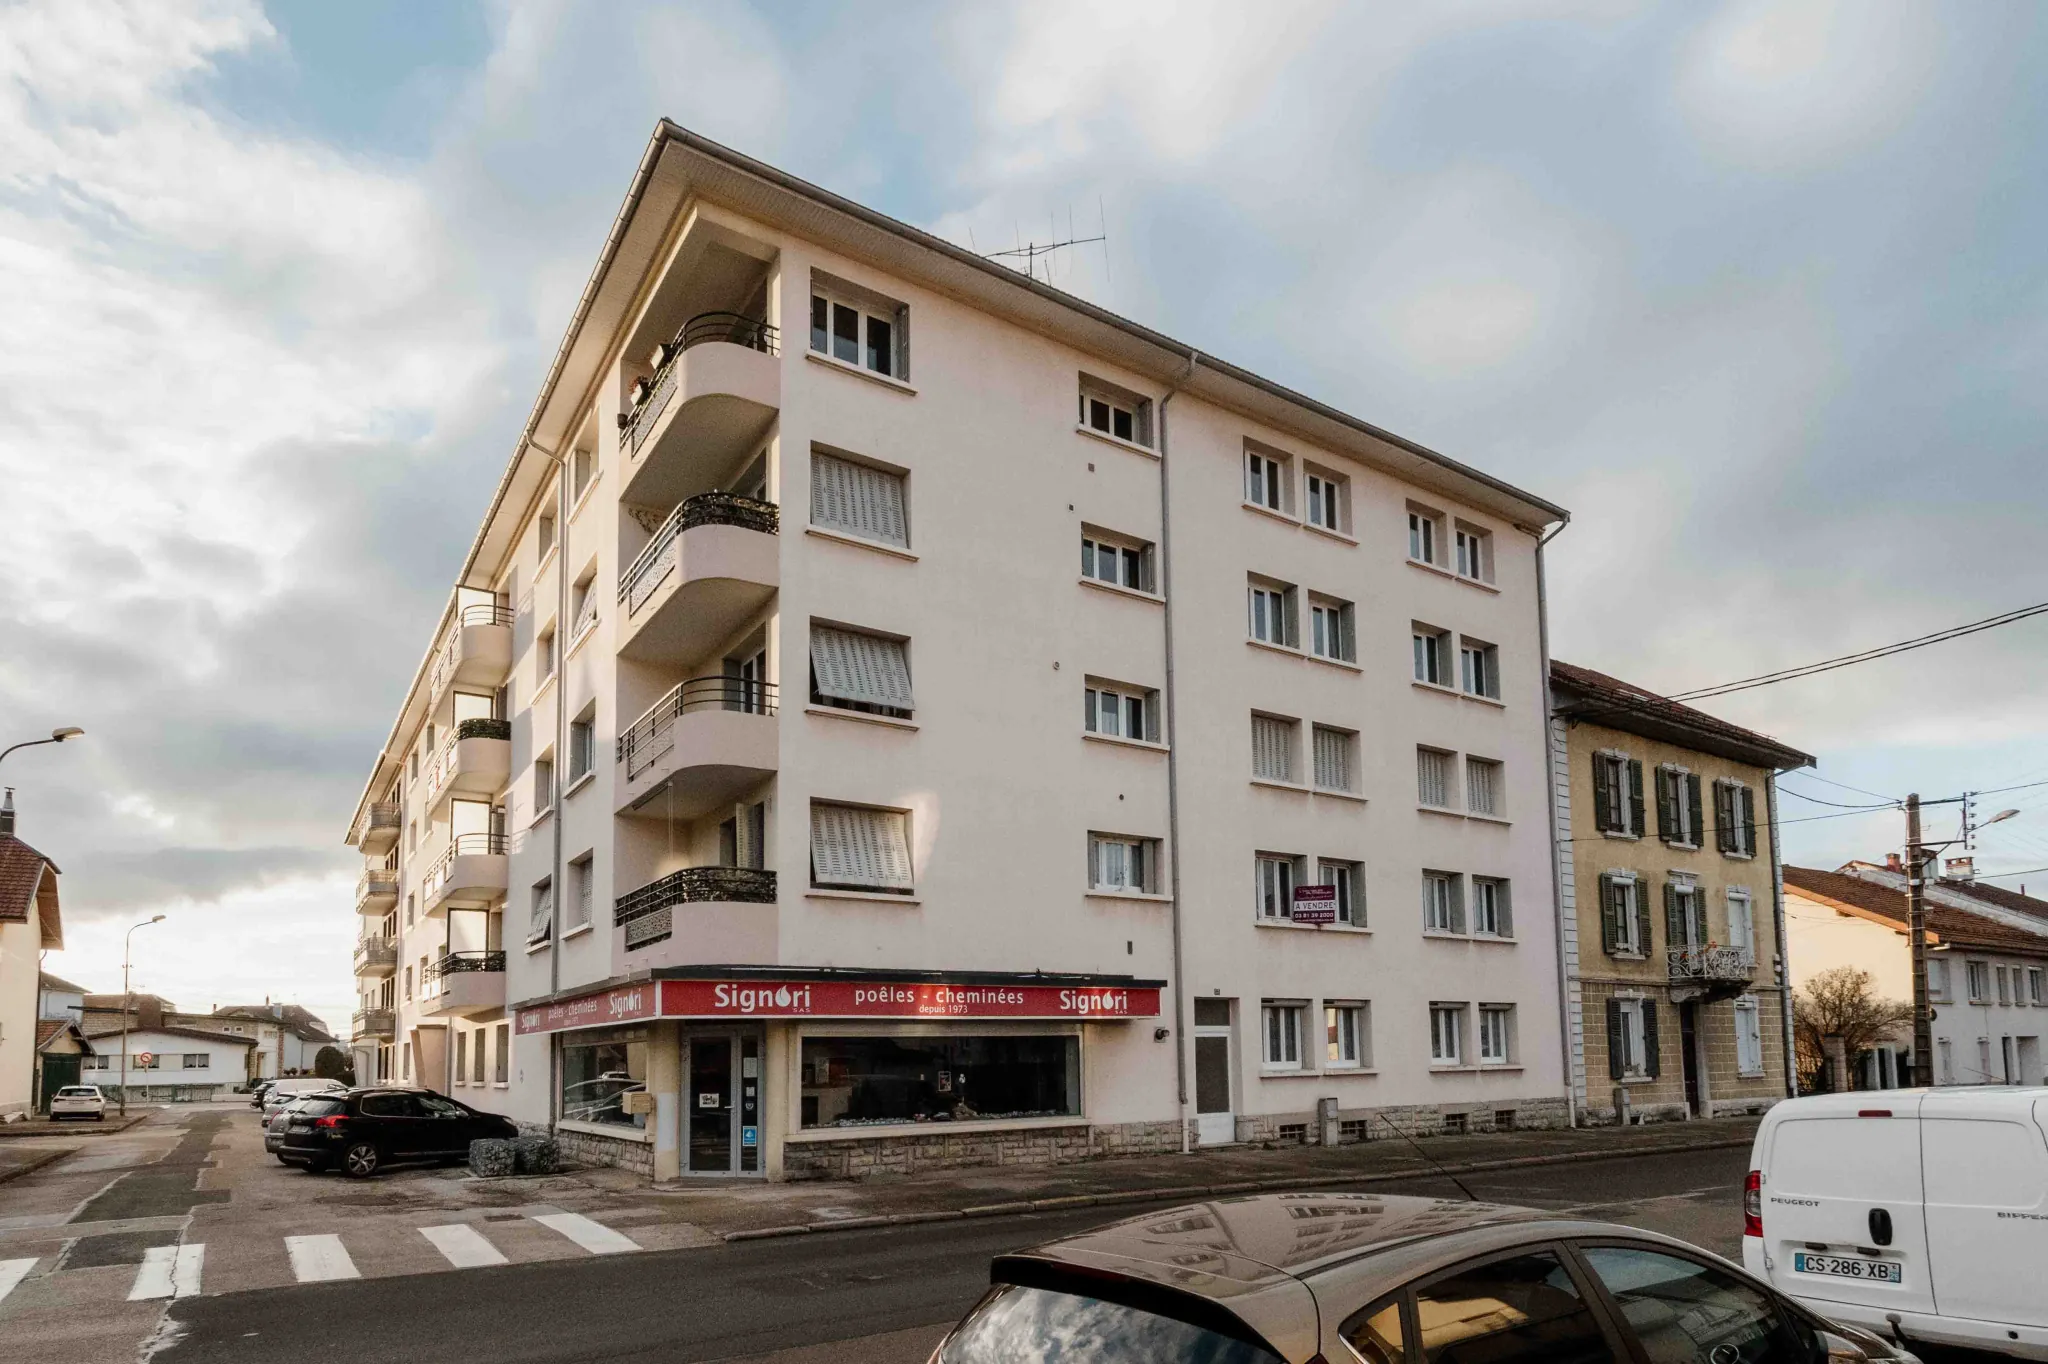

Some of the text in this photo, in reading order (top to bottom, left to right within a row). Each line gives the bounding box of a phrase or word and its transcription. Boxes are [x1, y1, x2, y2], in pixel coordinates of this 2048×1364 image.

[609, 988, 642, 1019] Signori
[713, 983, 811, 1013] Signori
[854, 986, 915, 1006] poêles
[935, 987, 1024, 1005] cheminées
[1059, 990, 1128, 1015] Signori
[568, 998, 598, 1016] cheminées
[918, 1004, 968, 1015] depuis 1973
[1770, 1197, 1821, 1207] PEUGEOT
